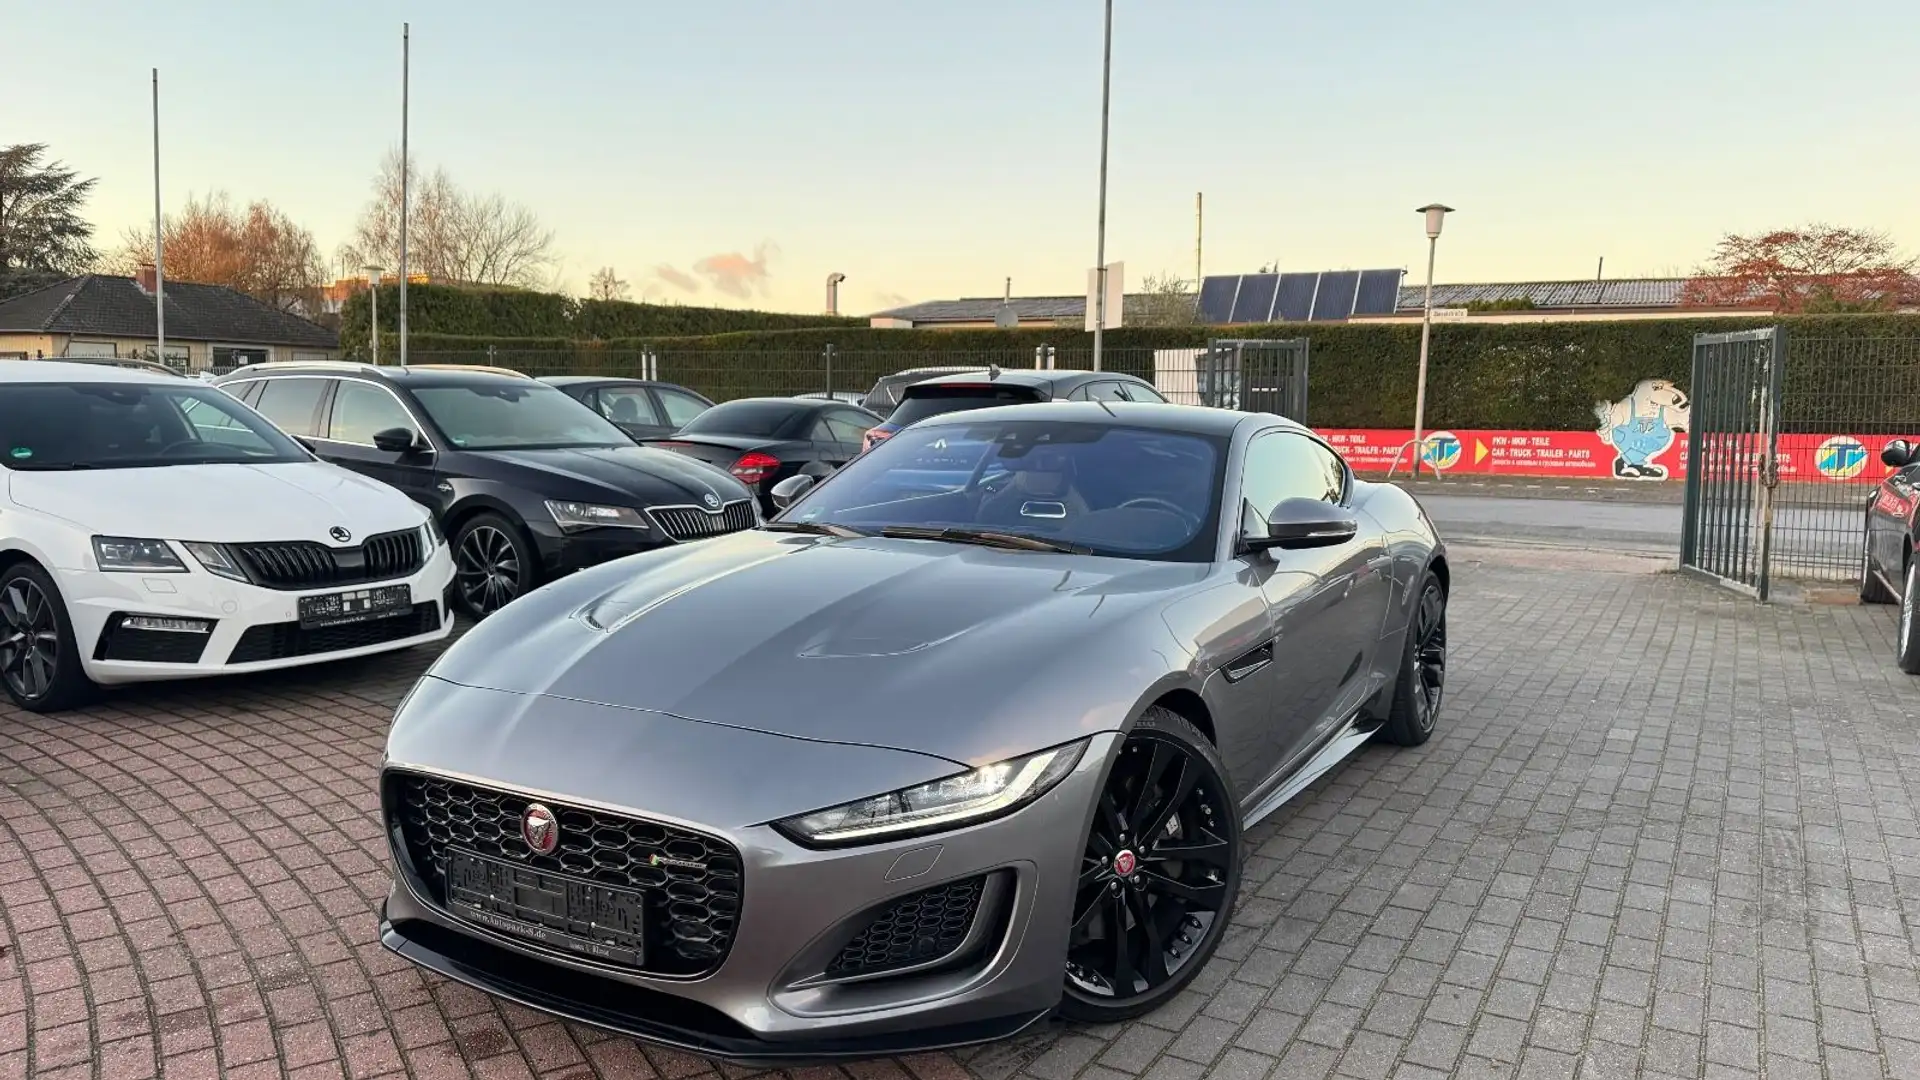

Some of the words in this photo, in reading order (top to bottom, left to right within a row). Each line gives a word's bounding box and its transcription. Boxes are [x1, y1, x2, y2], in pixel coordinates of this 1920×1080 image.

[1492, 436, 1507, 445] PKW
[1531, 437, 1550, 446] TEILE
[1491, 448, 1505, 457] CAR
[1510, 448, 1532, 457] TRUCK
[1536, 448, 1564, 458] TRAILER
[1568, 449, 1591, 459] PARTS
